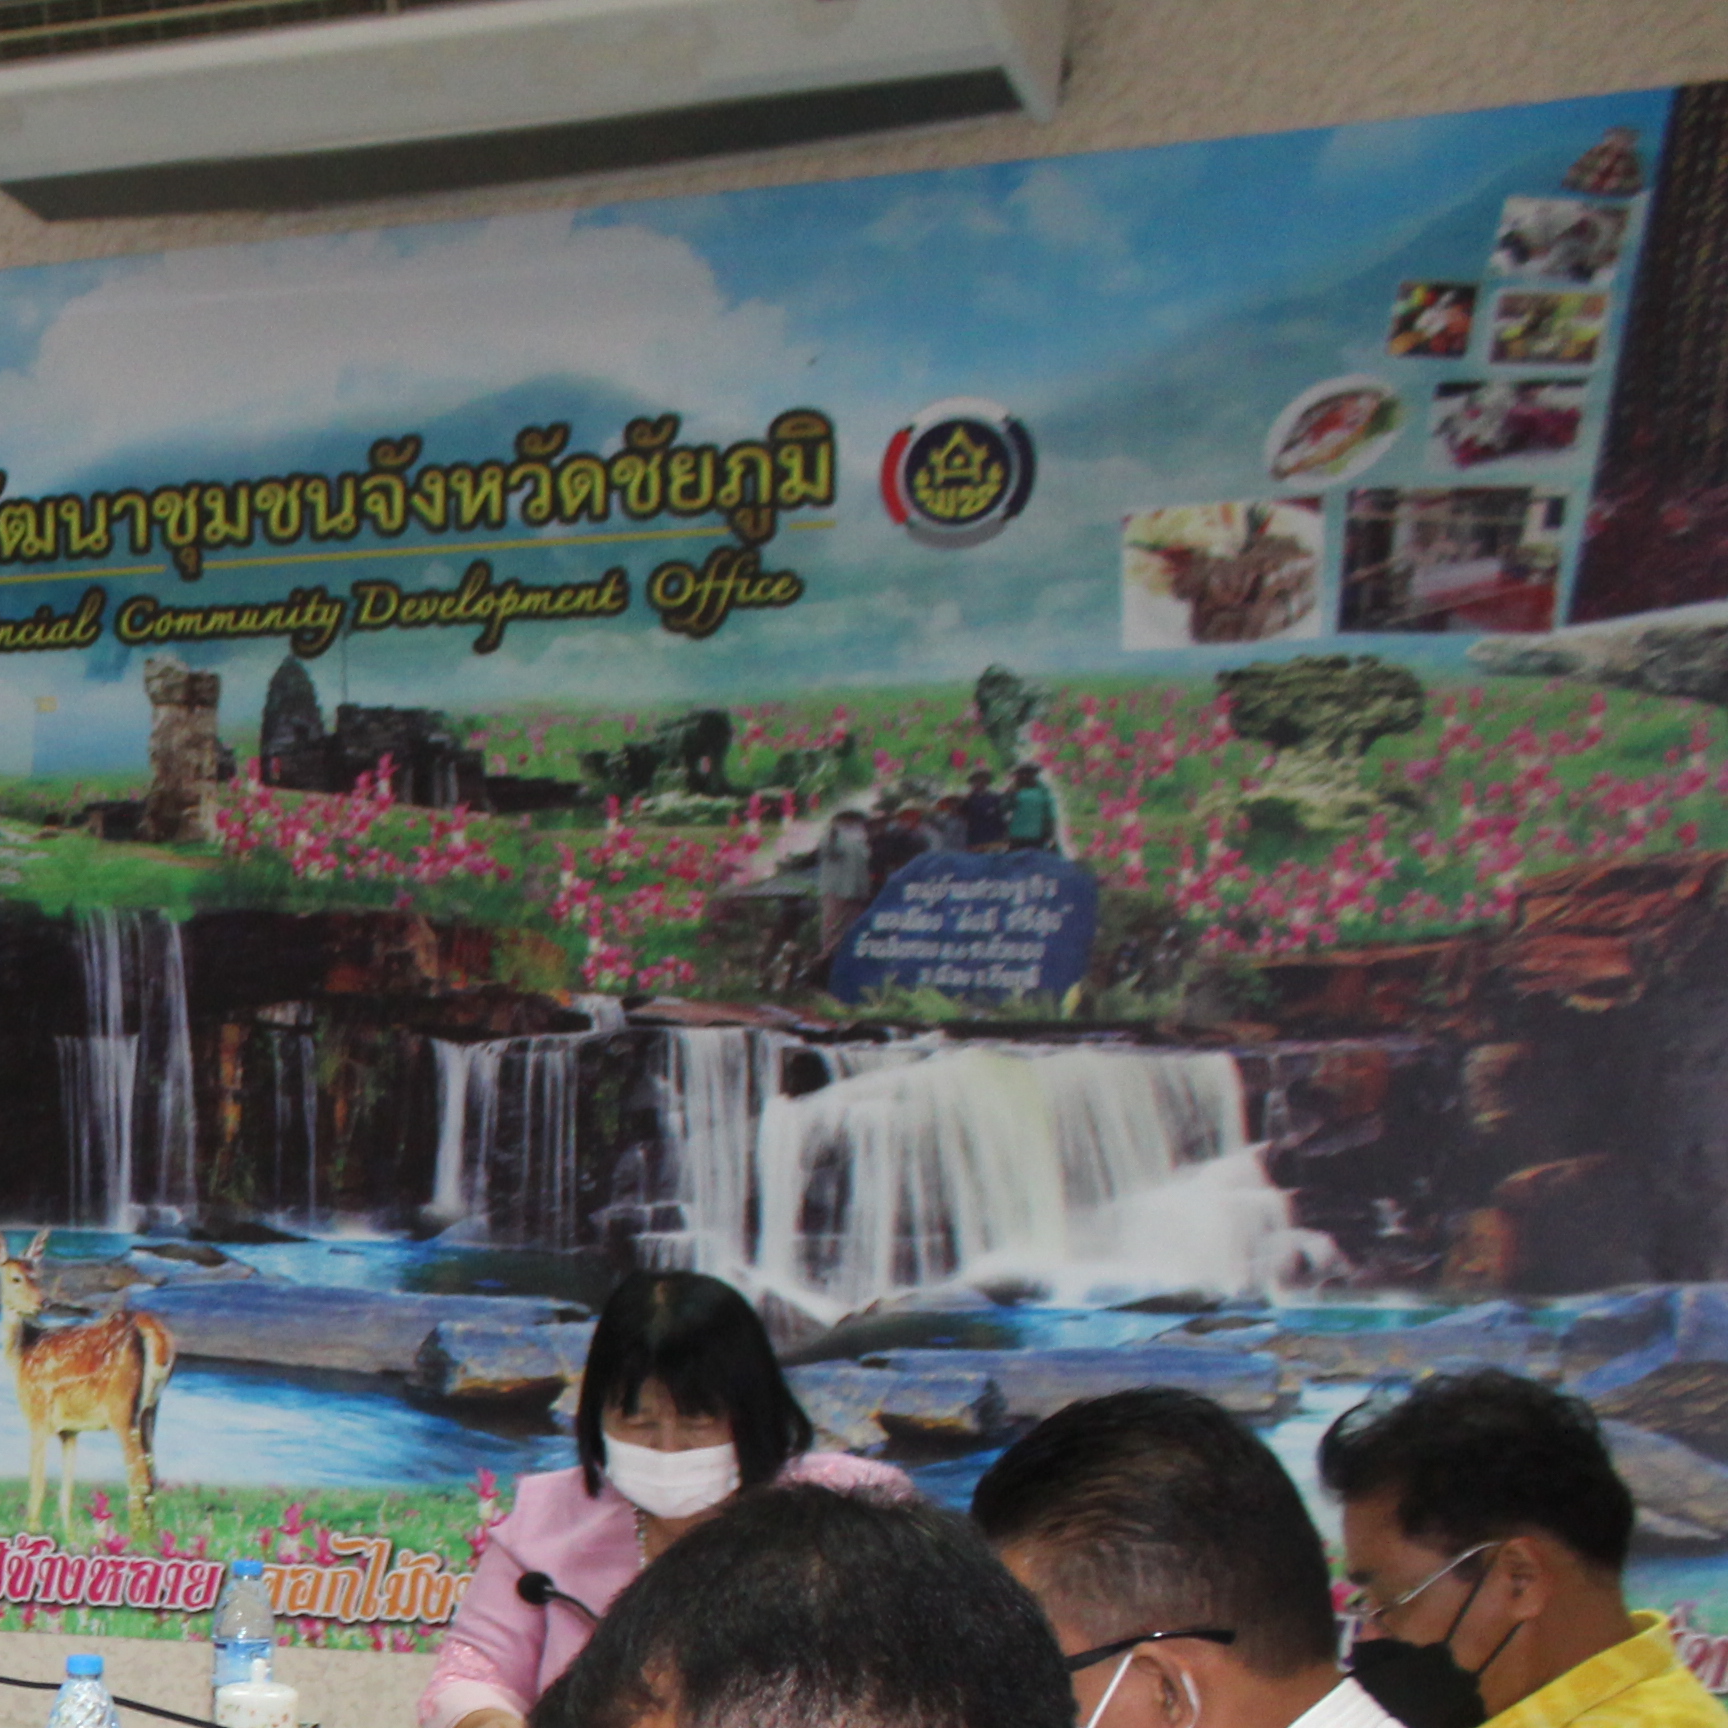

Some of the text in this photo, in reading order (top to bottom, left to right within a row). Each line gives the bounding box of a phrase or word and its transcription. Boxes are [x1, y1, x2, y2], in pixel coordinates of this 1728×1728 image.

[115, 587, 344, 657] Community
[351, 559, 630, 653] Development
[648, 547, 804, 639] Office
